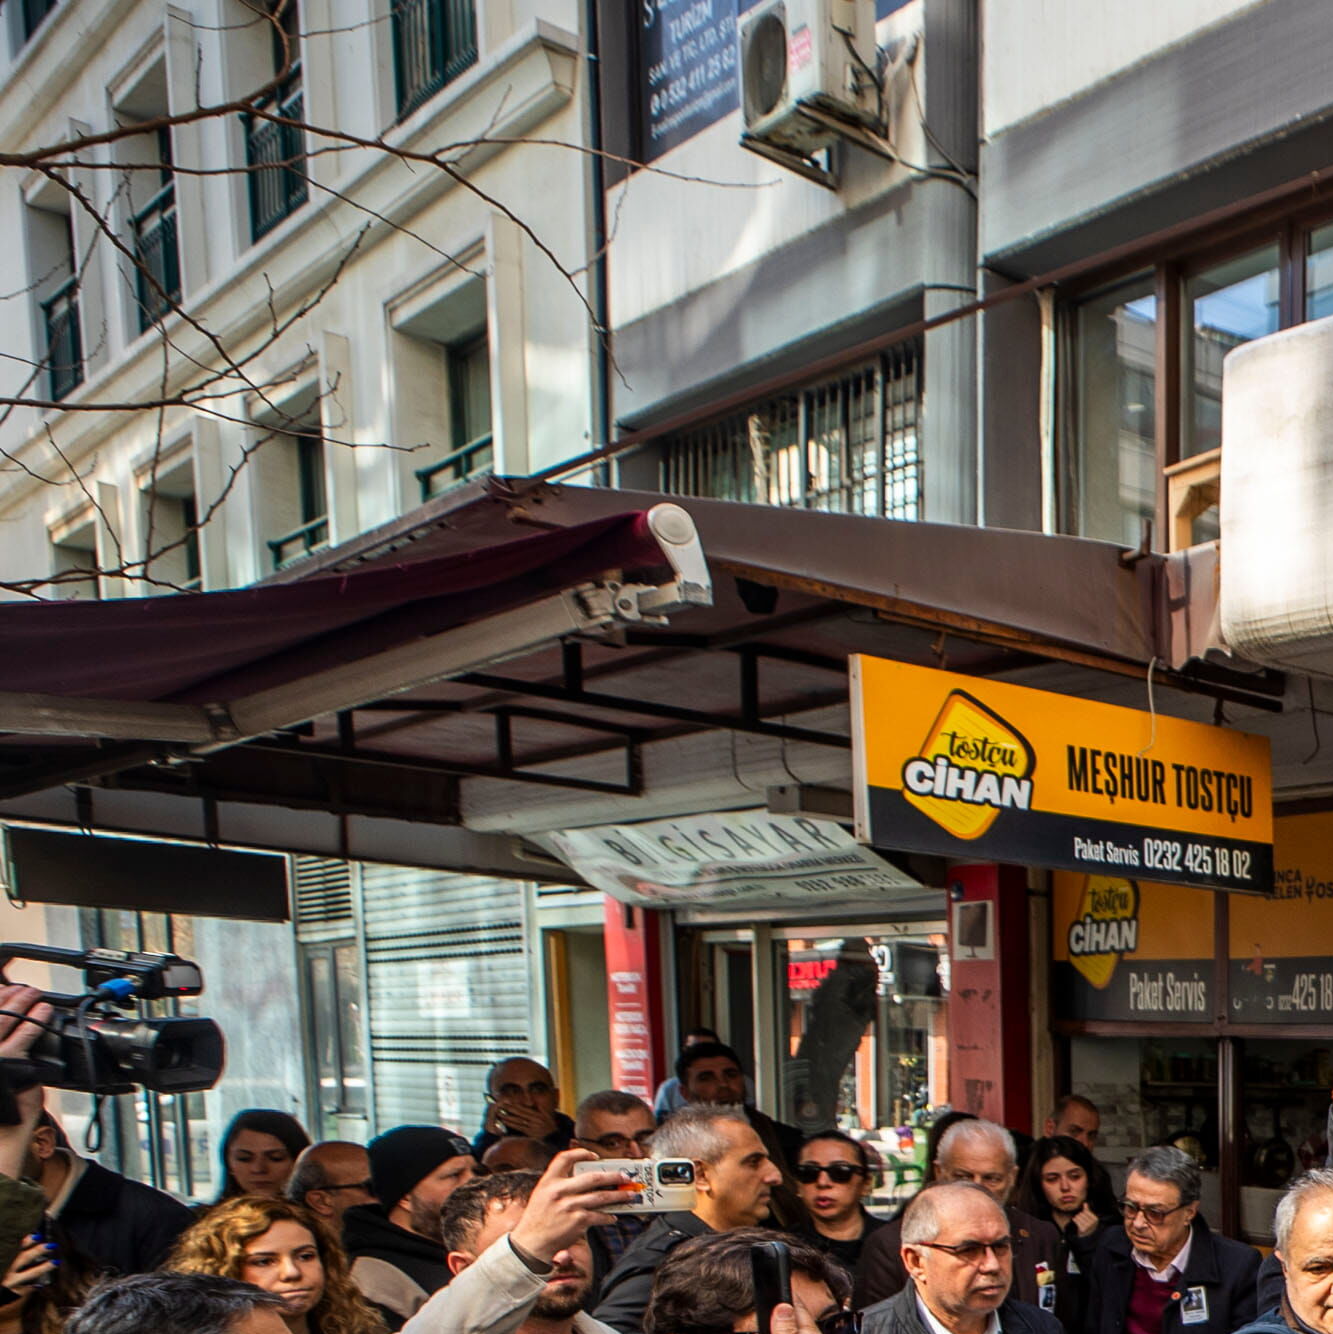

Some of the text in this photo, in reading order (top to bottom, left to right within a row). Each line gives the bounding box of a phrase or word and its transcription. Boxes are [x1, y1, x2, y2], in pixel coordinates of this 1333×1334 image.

[940, 729, 1018, 769] tostçu
[903, 756, 1033, 811] CİHAN
[1066, 744, 1253, 825] MEŞHUR TOSTÇU
[602, 816, 842, 868] BİLGİSAYAR
[1074, 836, 1252, 880] Paket Servis 0232 425 18 02
[1069, 914, 1138, 953] CİHAN
[1129, 972, 1164, 1011] Paket
[1166, 971, 1206, 1011] Servis
[1292, 972, 1317, 1012] 425
[1319, 972, 1333, 1012] 18
